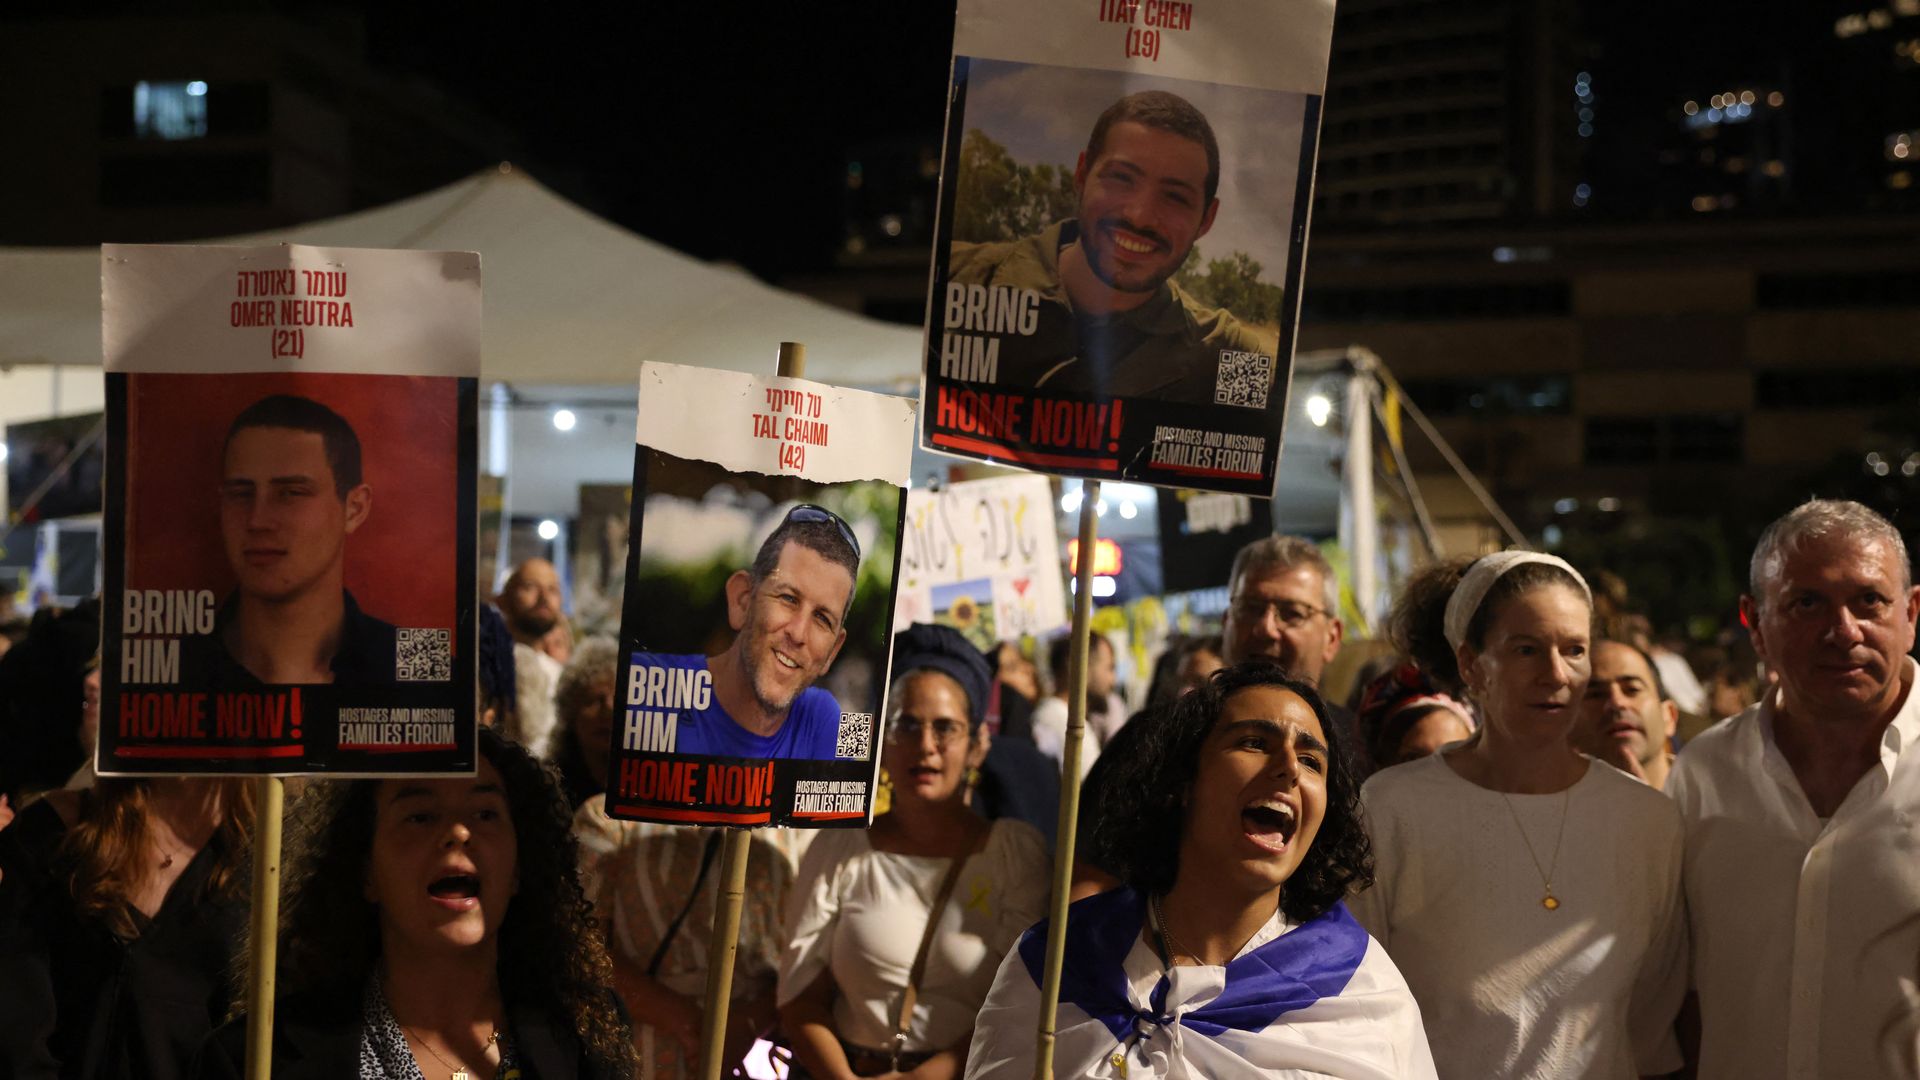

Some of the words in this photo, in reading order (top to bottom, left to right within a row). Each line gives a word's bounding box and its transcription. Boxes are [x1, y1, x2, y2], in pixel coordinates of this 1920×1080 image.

[1144, 0, 1192, 31] CHEN
[1125, 26, 1160, 62] (19)
[237, 269, 296, 297] נאוטרה
[302, 270, 347, 297] עומר
[230, 300, 276, 327] OMER
[281, 299, 353, 327] NEUTRA
[944, 282, 1039, 336] BRING
[271, 328, 304, 359] (21)
[940, 333, 1000, 384] HIM
[766, 388, 804, 415] חיימי
[807, 392, 822, 418] טל
[752, 413, 779, 439] TAL
[784, 417, 829, 446] CHAIMI
[936, 386, 1023, 439] HOME
[1030, 399, 1124, 452] NOW!
[1155, 425, 1203, 445] HOSTAGES
[1203, 431, 1222, 447] AND
[1223, 433, 1265, 452] MISSING
[779, 442, 805, 472] (42)
[1151, 441, 1213, 469] FAMILIES
[1214, 448, 1263, 474] FORUM
[122, 589, 215, 635] BRING
[120, 639, 180, 684] HIM
[626, 664, 712, 711] BRING
[119, 693, 207, 738] HOME
[216, 688, 303, 738] NOW!
[339, 708, 389, 723] HOSTAGES
[390, 708, 410, 722] AND
[411, 708, 455, 723] MISSING
[339, 723, 402, 745] FAMILIES
[405, 723, 455, 745] FORUM
[623, 710, 678, 753] HIM
[619, 758, 700, 804] HOME
[704, 761, 774, 807] NOW!
[796, 780, 828, 794] HOSTAGES
[828, 781, 841, 794] AND
[840, 781, 867, 794] MISSING
[794, 793, 834, 812] FAMILIES
[834, 794, 866, 812] FORUM
